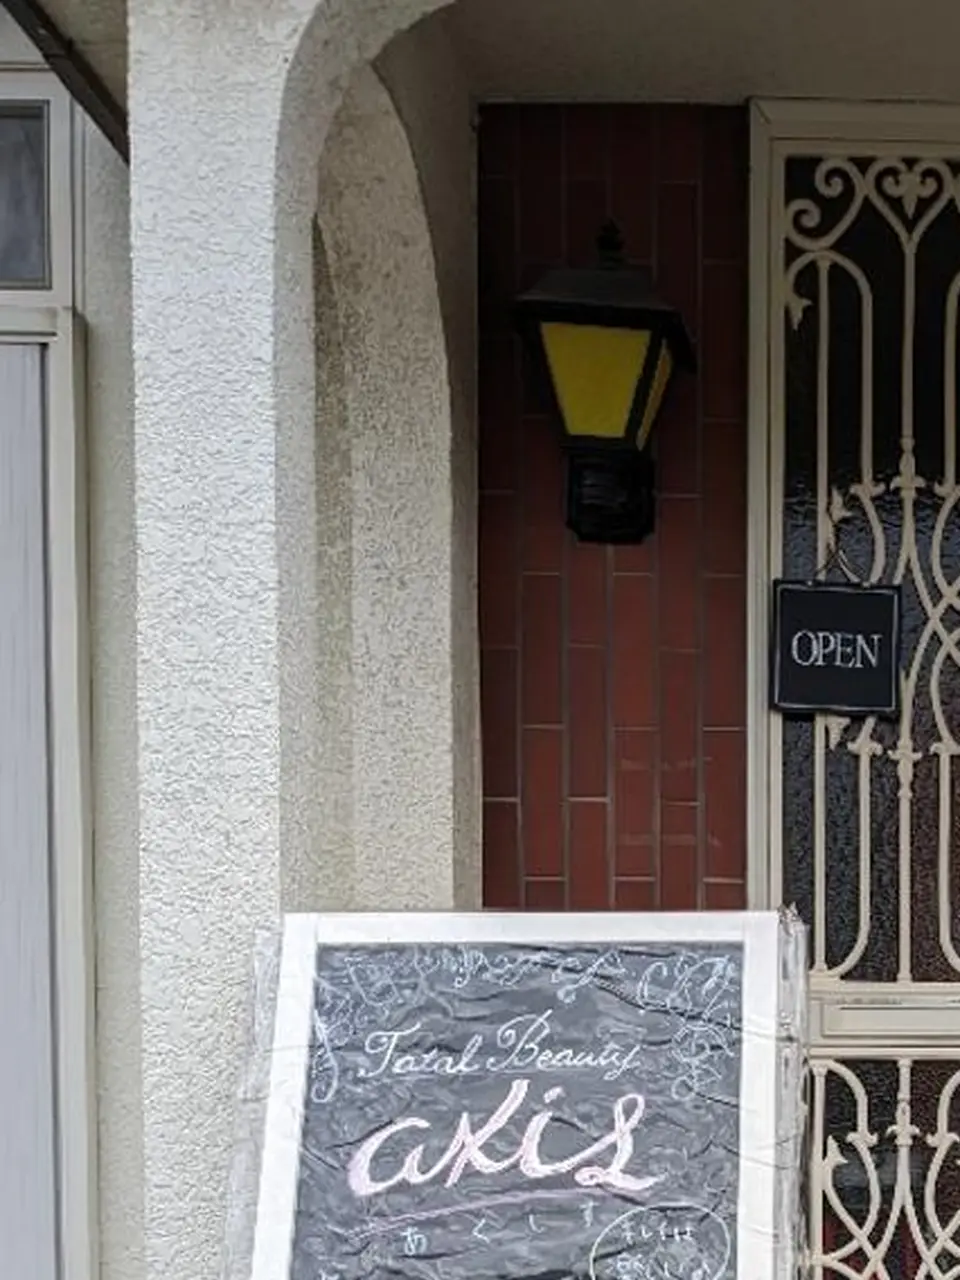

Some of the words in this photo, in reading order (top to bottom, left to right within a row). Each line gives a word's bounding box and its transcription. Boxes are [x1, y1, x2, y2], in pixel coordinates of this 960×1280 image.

[792, 630, 882, 668] OPEN
[358, 1023, 484, 1078] Total
[486, 1009, 643, 1081] Beauty
